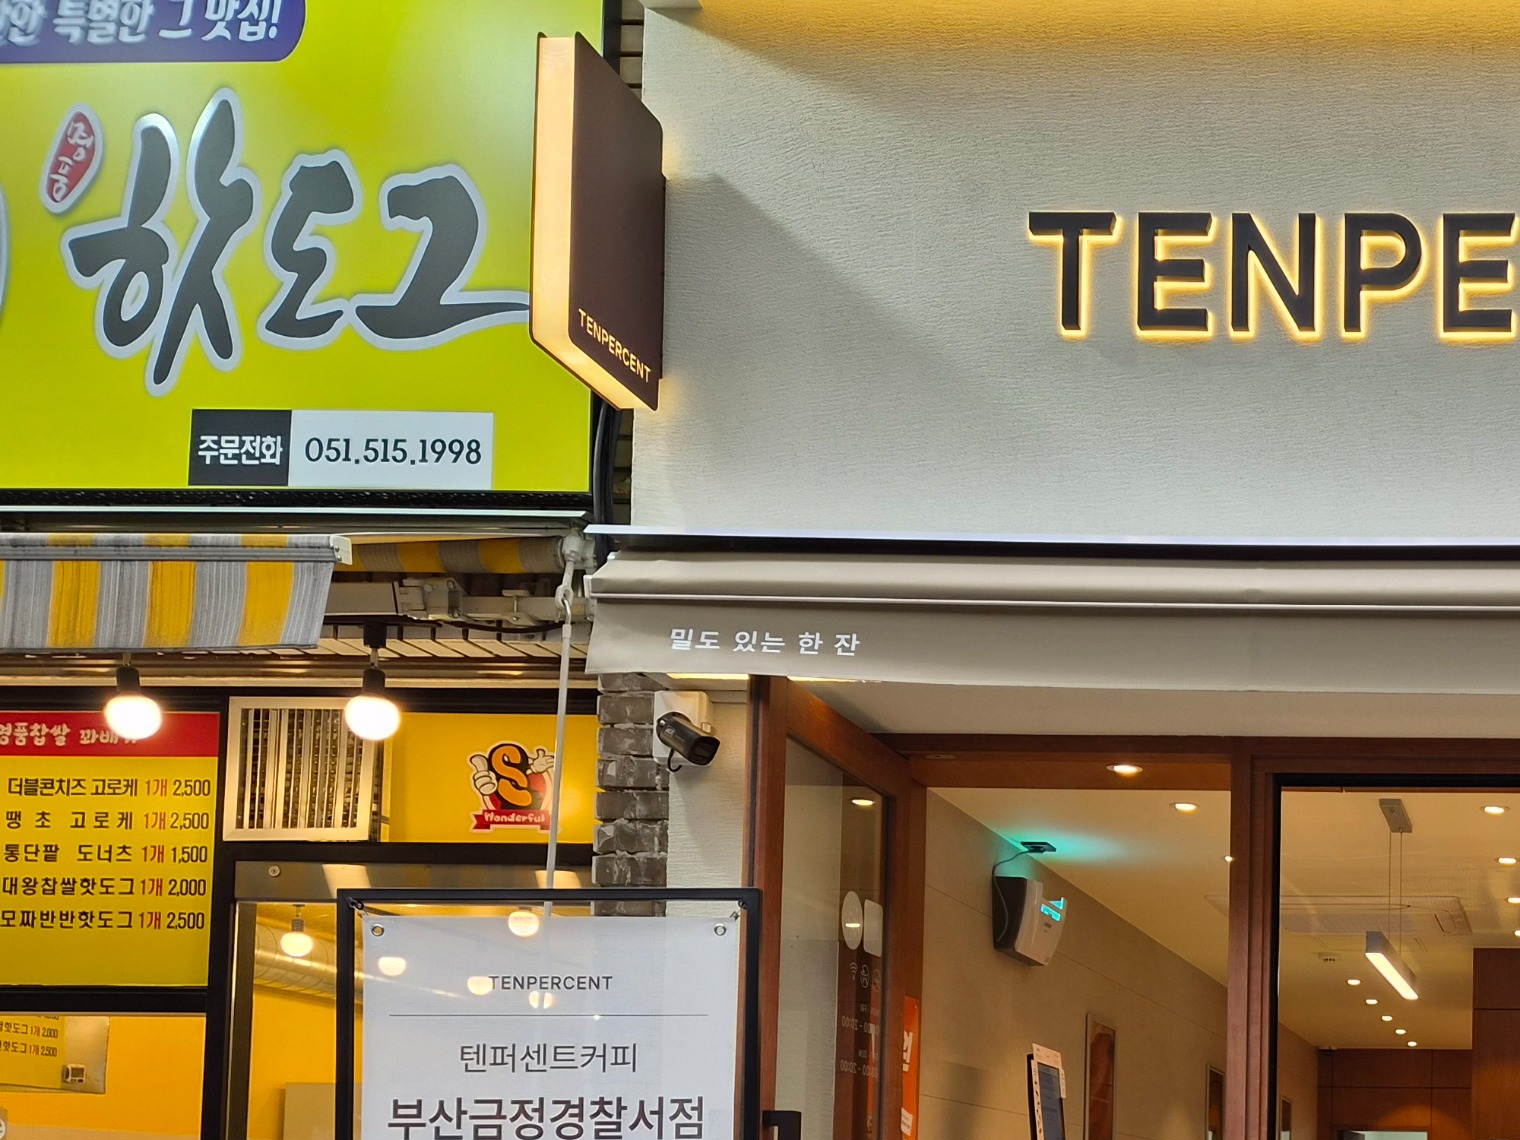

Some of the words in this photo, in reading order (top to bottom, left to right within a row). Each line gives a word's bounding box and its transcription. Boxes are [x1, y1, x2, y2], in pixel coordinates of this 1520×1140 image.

[64, 92, 532, 392] 핫도그
[577, 307, 652, 384] TENPERCENT
[197, 433, 284, 467] 주문전화
[304, 437, 483, 467] 051.515.1998
[670, 628, 720, 650] 밀도
[732, 630, 786, 654] 있는
[798, 631, 824, 655] 한
[833, 633, 861, 657] 잔
[79, 727, 139, 747] 꽈배
[8, 777, 87, 797] 더블콘치즈
[90, 778, 139, 797] 고로케
[145, 779, 169, 798] 1개
[172, 779, 212, 798] 2,500
[143, 812, 168, 831] 1개
[169, 812, 211, 831] 2,500
[483, 810, 546, 823] Wonderful
[3, 843, 60, 863] 통단팥
[77, 844, 133, 864] 도너츠
[141, 845, 166, 864] 1개
[170, 845, 209, 865] 1,500
[2, 876, 135, 897] 대왕찹쌀핫도그
[139, 878, 164, 897] 1개
[168, 878, 208, 898] 2,000
[0, 910, 134, 930] 모짜반반핫도그
[138, 911, 162, 930] 1개
[166, 911, 206, 931] 2,500
[488, 975, 613, 991] TENPERCENT
[459, 1042, 638, 1074] 텐퍼센트커피
